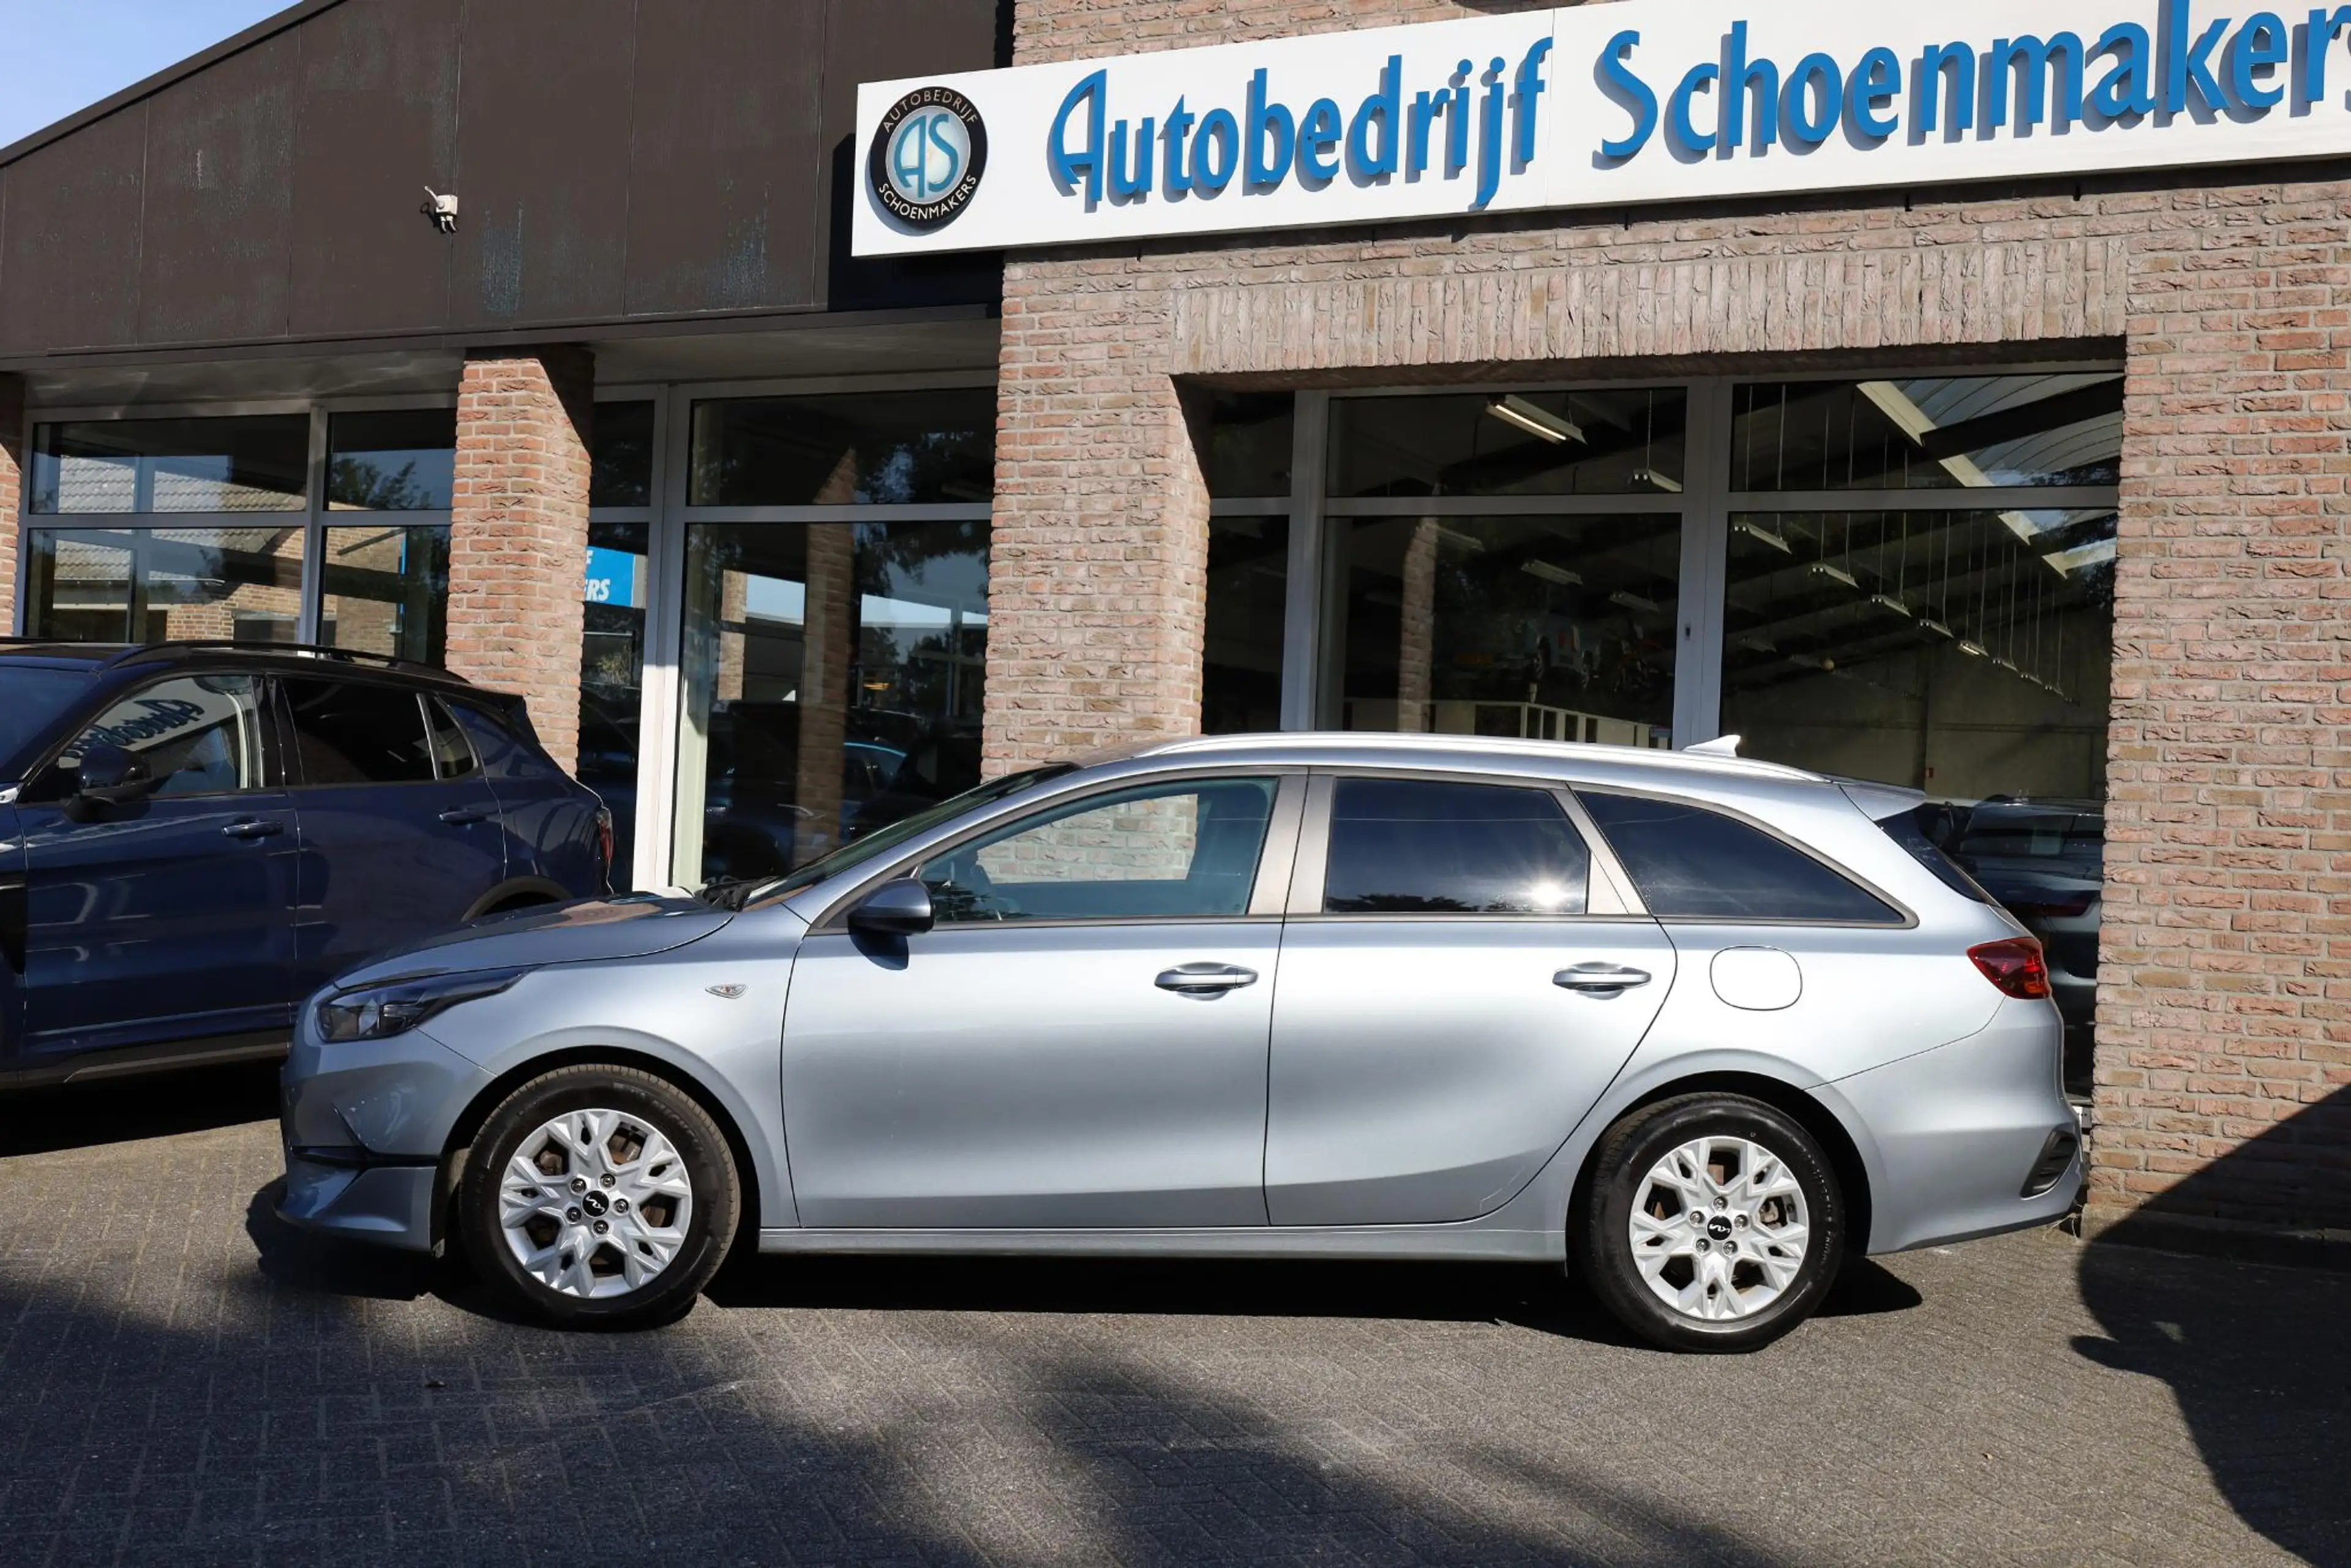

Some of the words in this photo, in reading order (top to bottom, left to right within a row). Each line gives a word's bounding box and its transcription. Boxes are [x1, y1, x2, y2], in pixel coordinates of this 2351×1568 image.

[883, 89, 979, 133] AUTOBEDRIJF
[1052, 38, 1553, 207] Autobedrijf
[1602, 0, 2351, 157] Schoenmaker
[894, 113, 959, 198] AS
[879, 173, 977, 220] SCHOENMAKERS
